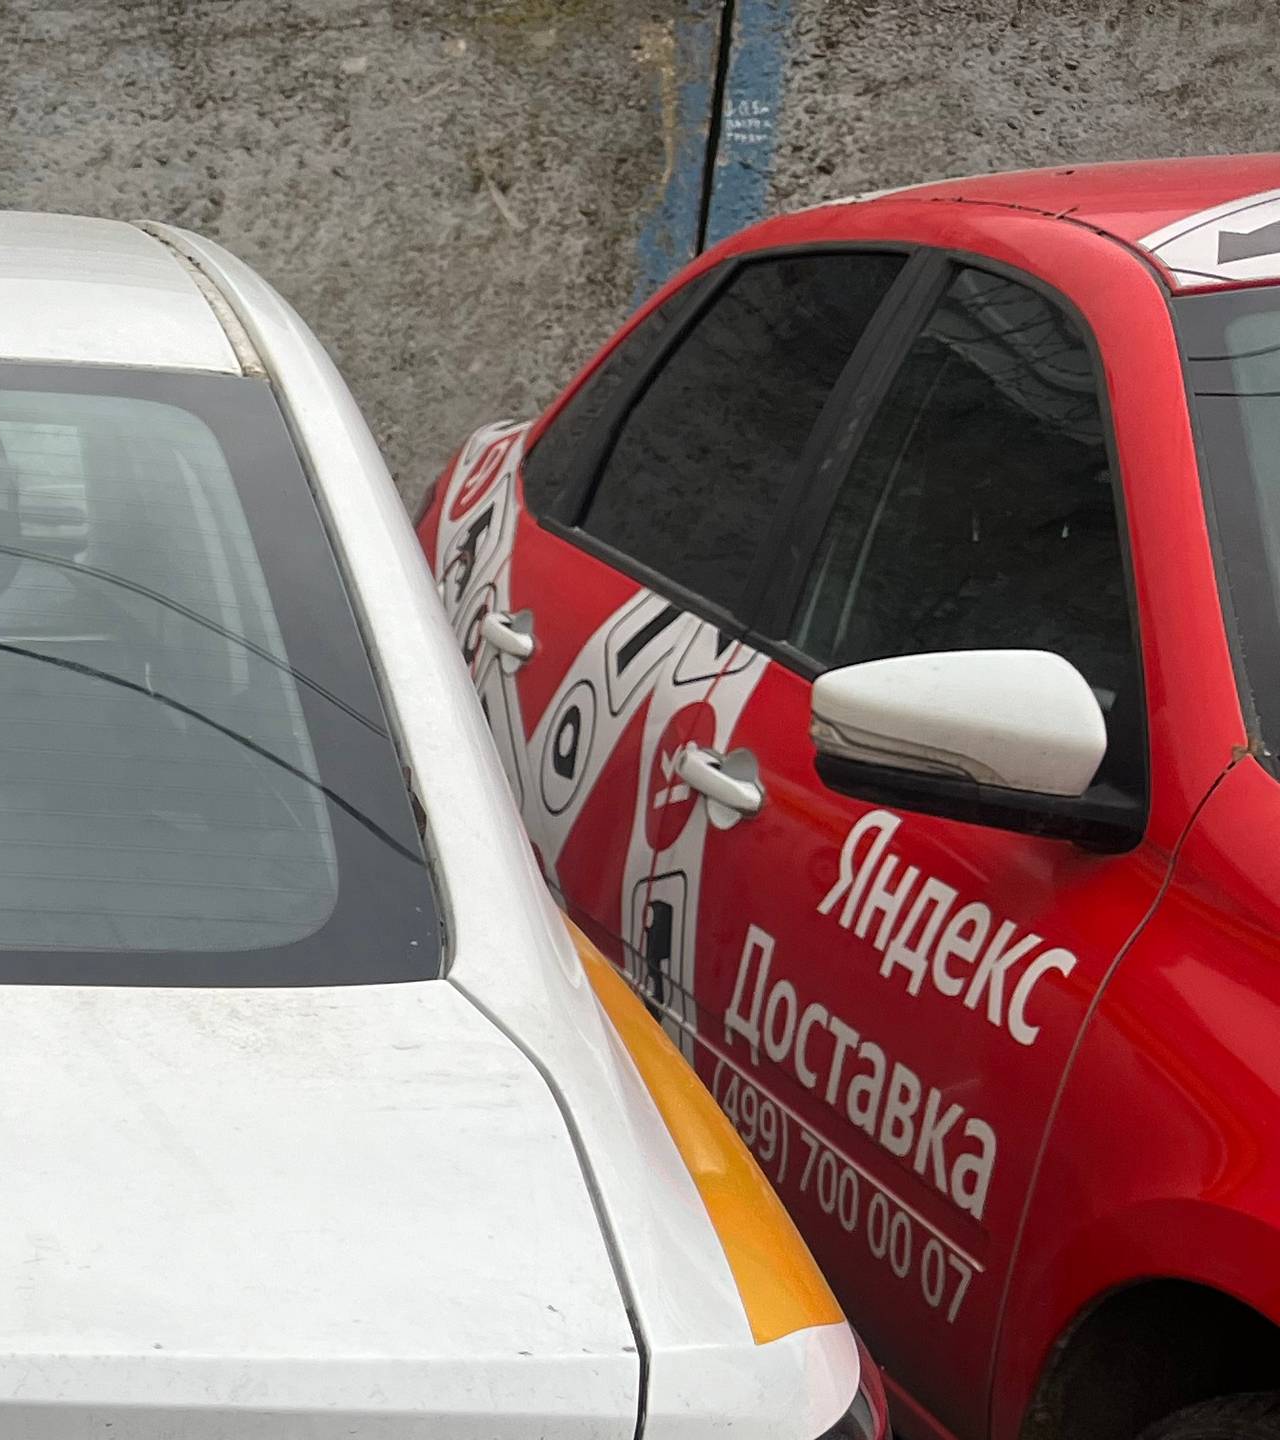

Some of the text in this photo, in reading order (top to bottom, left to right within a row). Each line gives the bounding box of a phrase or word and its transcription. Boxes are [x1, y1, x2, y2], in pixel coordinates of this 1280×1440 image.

[817, 809, 1077, 1046] Яндекс
[725, 924, 997, 1220] Доставка
[800, 1131, 860, 1234] 700
[867, 1192, 913, 1279] 00
[921, 1243, 974, 1324] 07
